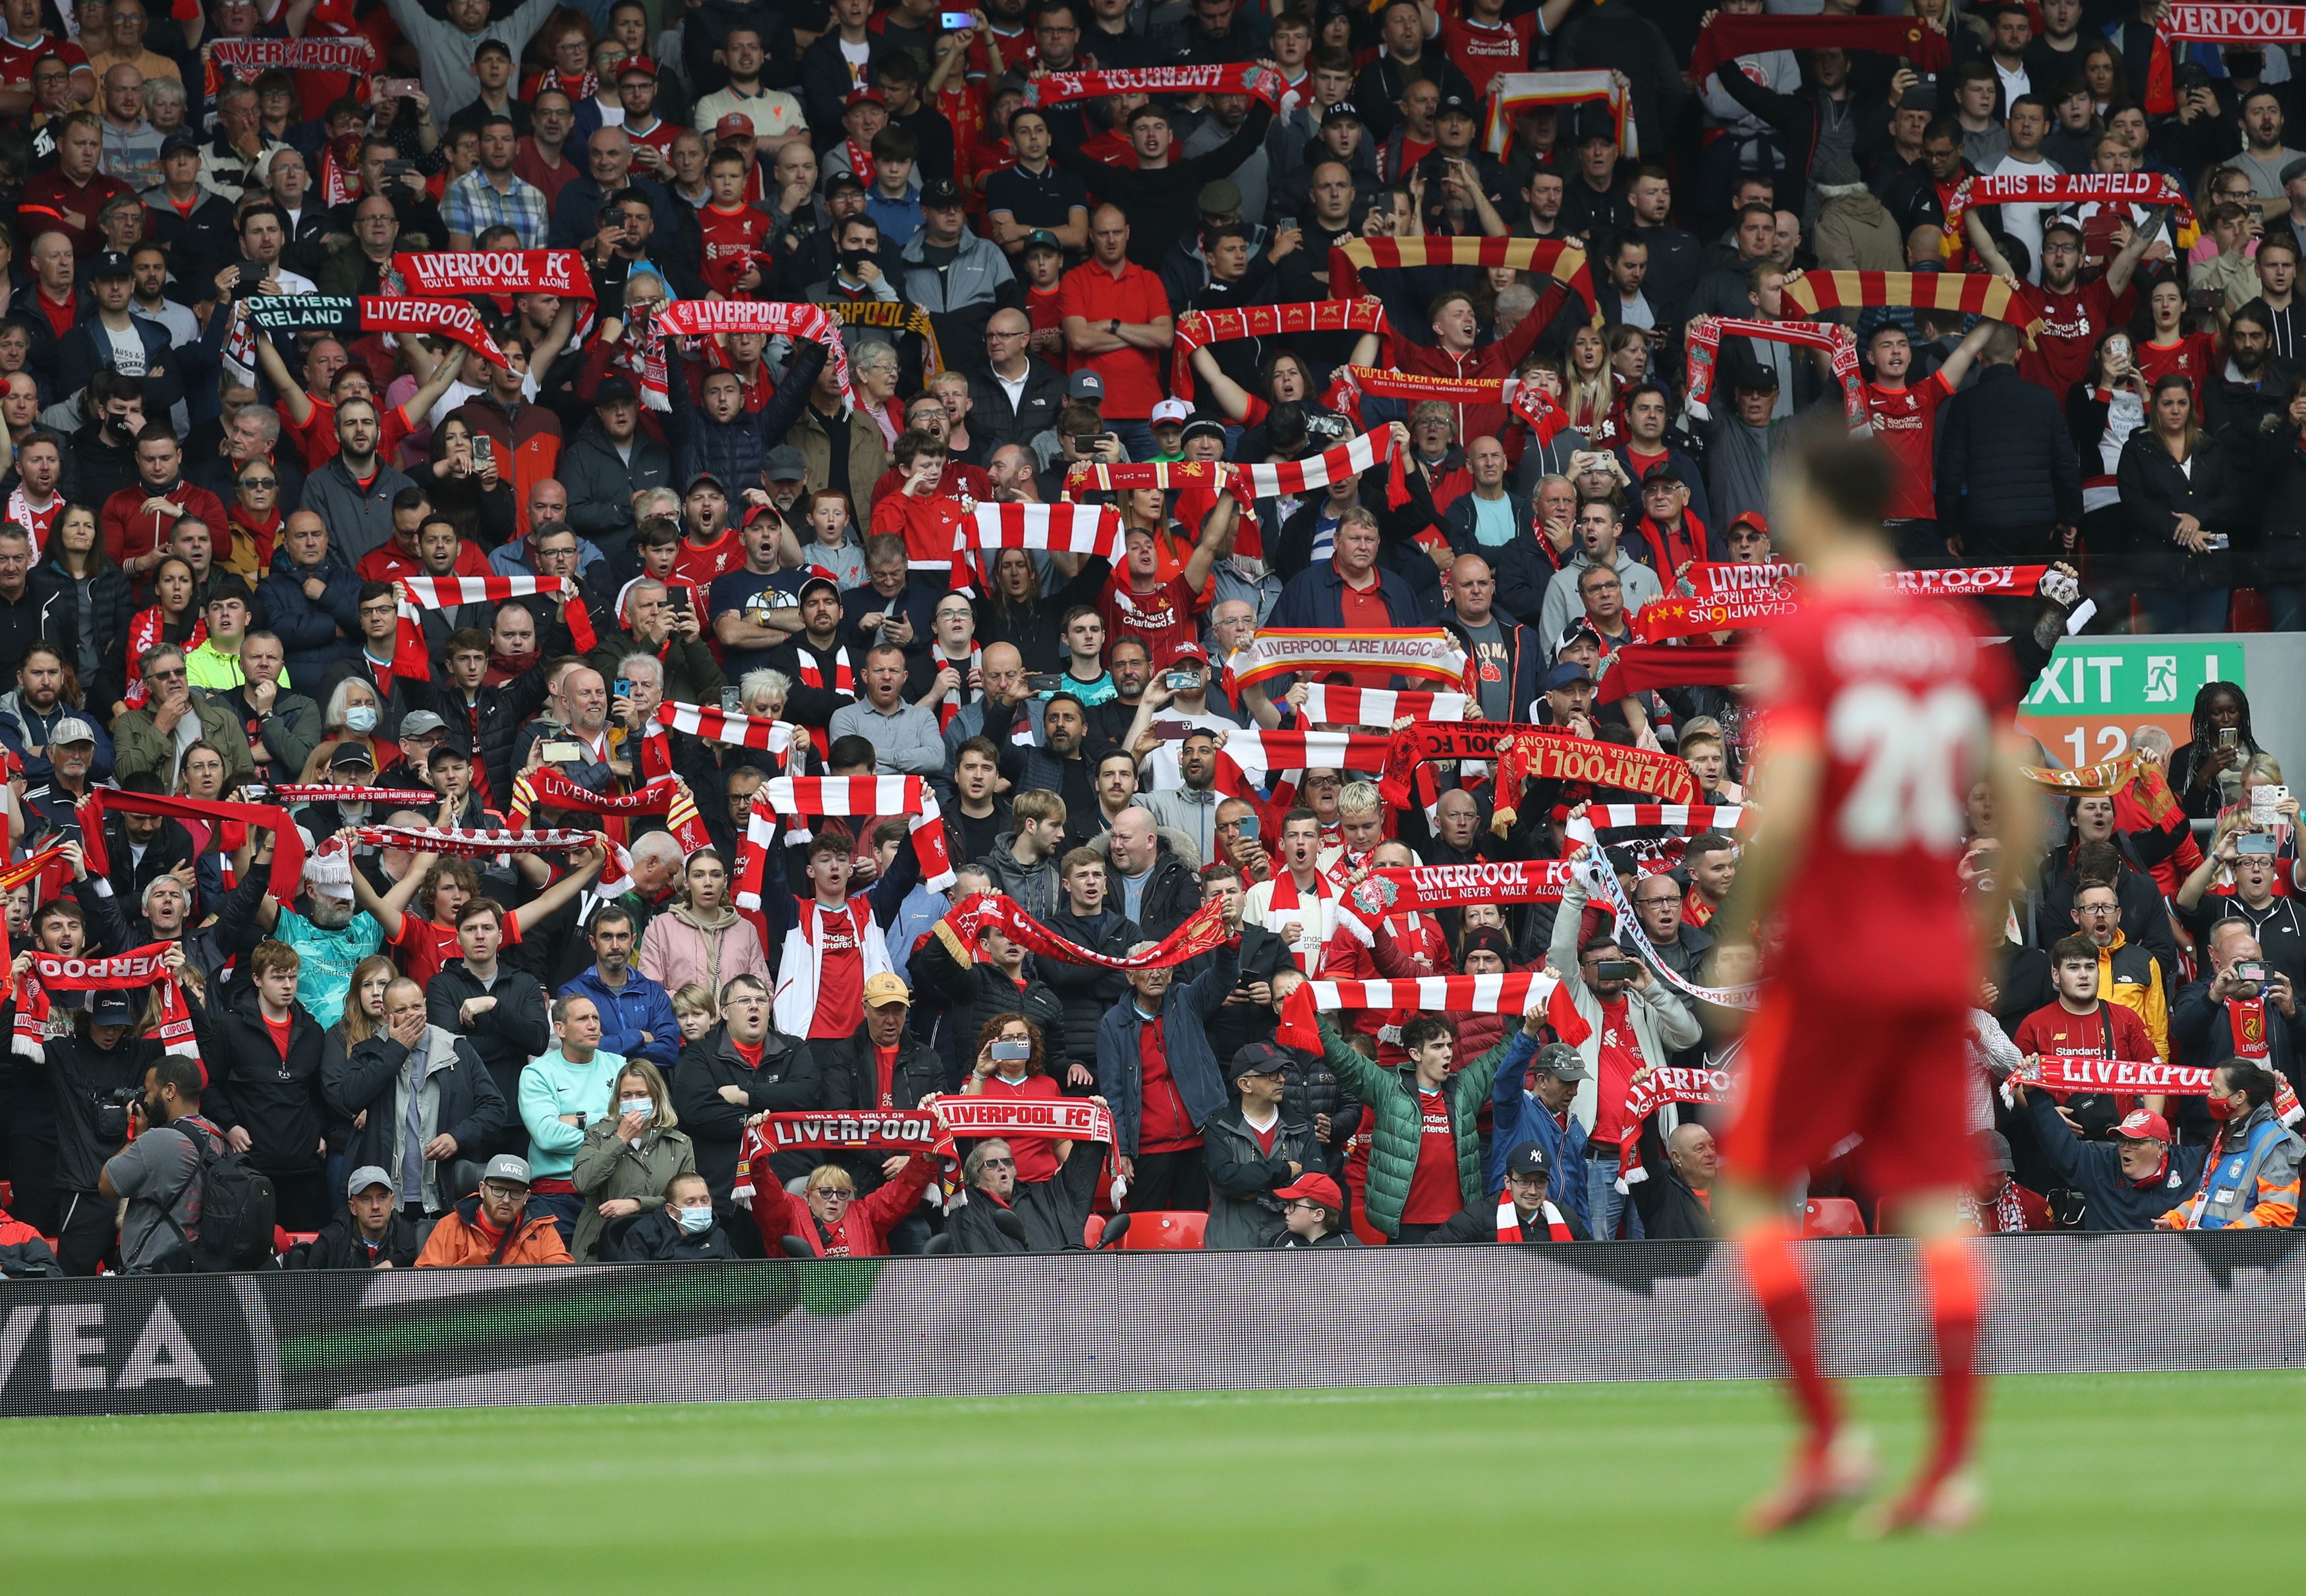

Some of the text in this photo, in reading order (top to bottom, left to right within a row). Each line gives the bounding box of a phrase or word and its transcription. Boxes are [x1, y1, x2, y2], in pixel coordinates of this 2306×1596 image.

[2170, 6, 2297, 36] VERPOOL
[1981, 173, 2151, 195] THIS IS ANFIELD
[412, 253, 571, 279] LIVERPOOL FC
[422, 277, 570, 289] YOU'LL NEVER WALK ALONE
[248, 296, 352, 311] ORTHERN
[367, 301, 474, 334] LIVERPOOL
[694, 301, 790, 325] LIVERPOOL
[739, 323, 773, 331] MERSEYSIDE
[1353, 366, 1390, 381] YOU'LL
[1393, 371, 1429, 385] NEVER
[1465, 378, 1501, 387] ALONE
[1706, 563, 1811, 592] LIVERPOO
[1878, 570, 2015, 589] ERPOOL
[1123, 617, 1167, 628] Chartered
[1258, 638, 1432, 658] LIVERPOOL ARE MAGIC
[2019, 656, 2123, 704] XIT
[1517, 736, 1561, 751] ALONE
[1565, 740, 1603, 756] WALK
[2064, 726, 2127, 768] 12
[1609, 748, 1652, 763] NEVER
[1656, 756, 1689, 777] OU'LL
[646, 788, 663, 805] FC
[1409, 862, 1572, 891] LIVERPOOL FC
[1417, 885, 1564, 902] YOU'LL NEVER WALK ALON
[823, 941, 852, 950] artered
[40, 954, 165, 978] VERPOO
[316, 957, 357, 966] Standard
[312, 966, 353, 977] Chartere
[2056, 1047, 2100, 1056] Standard
[1625, 1068, 1737, 1116] LIVERPO
[1674, 1089, 1711, 1101] NEVER
[942, 1106, 1090, 1127] LIVERPOOL FC
[1098, 1106, 1108, 1123] 189
[1424, 1114, 1448, 1123] ndard
[774, 1119, 934, 1145] LIVERPOOL
[1421, 1124, 1449, 1134] rtered
[500, 1163, 524, 1176] VANS
